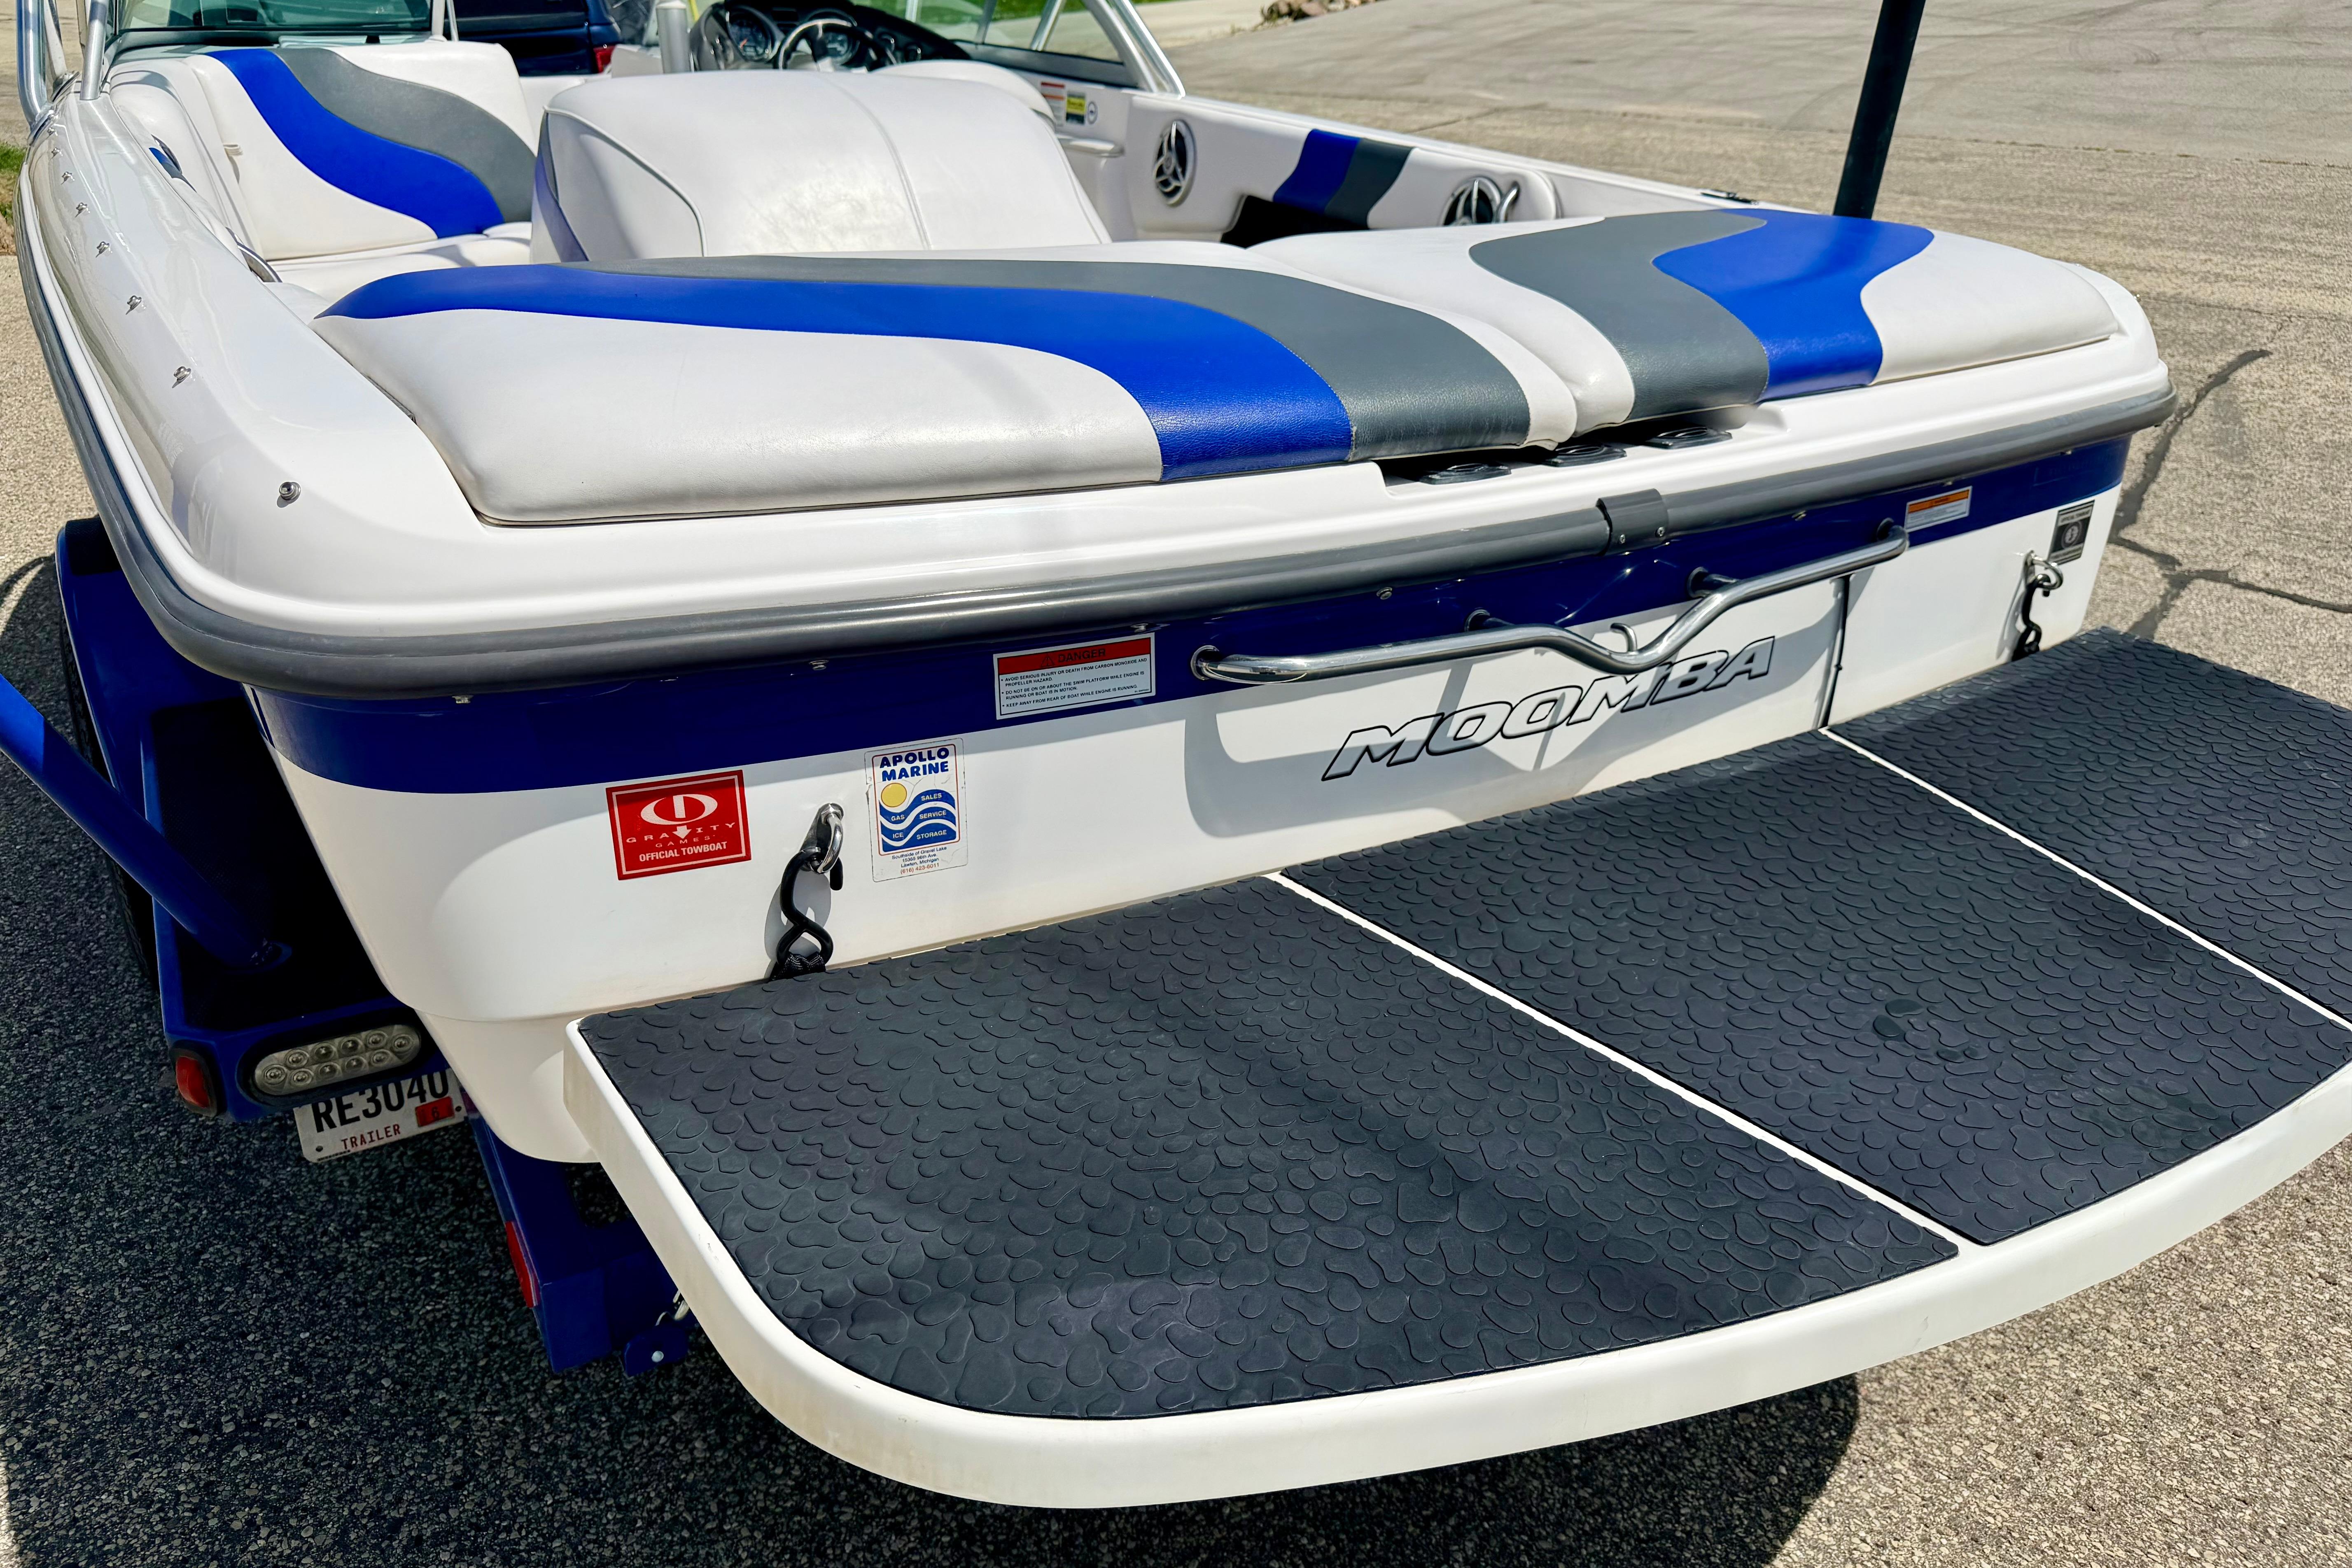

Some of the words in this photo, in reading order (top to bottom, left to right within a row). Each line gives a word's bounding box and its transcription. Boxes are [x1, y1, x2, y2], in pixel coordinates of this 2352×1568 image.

[1058, 648, 1106, 662] DANGER
[1321, 636, 1776, 781] MOOMBA
[880, 747, 949, 768] APOLLO
[882, 761, 949, 782] MARINE
[919, 810, 947, 819] SERVICE
[656, 835, 710, 848] GAMES
[917, 830, 947, 840] STORAGE
[639, 849, 679, 862] OFFICIAL
[681, 841, 727, 855] TOWBOAT
[341, 1124, 401, 1150] TRAILER
